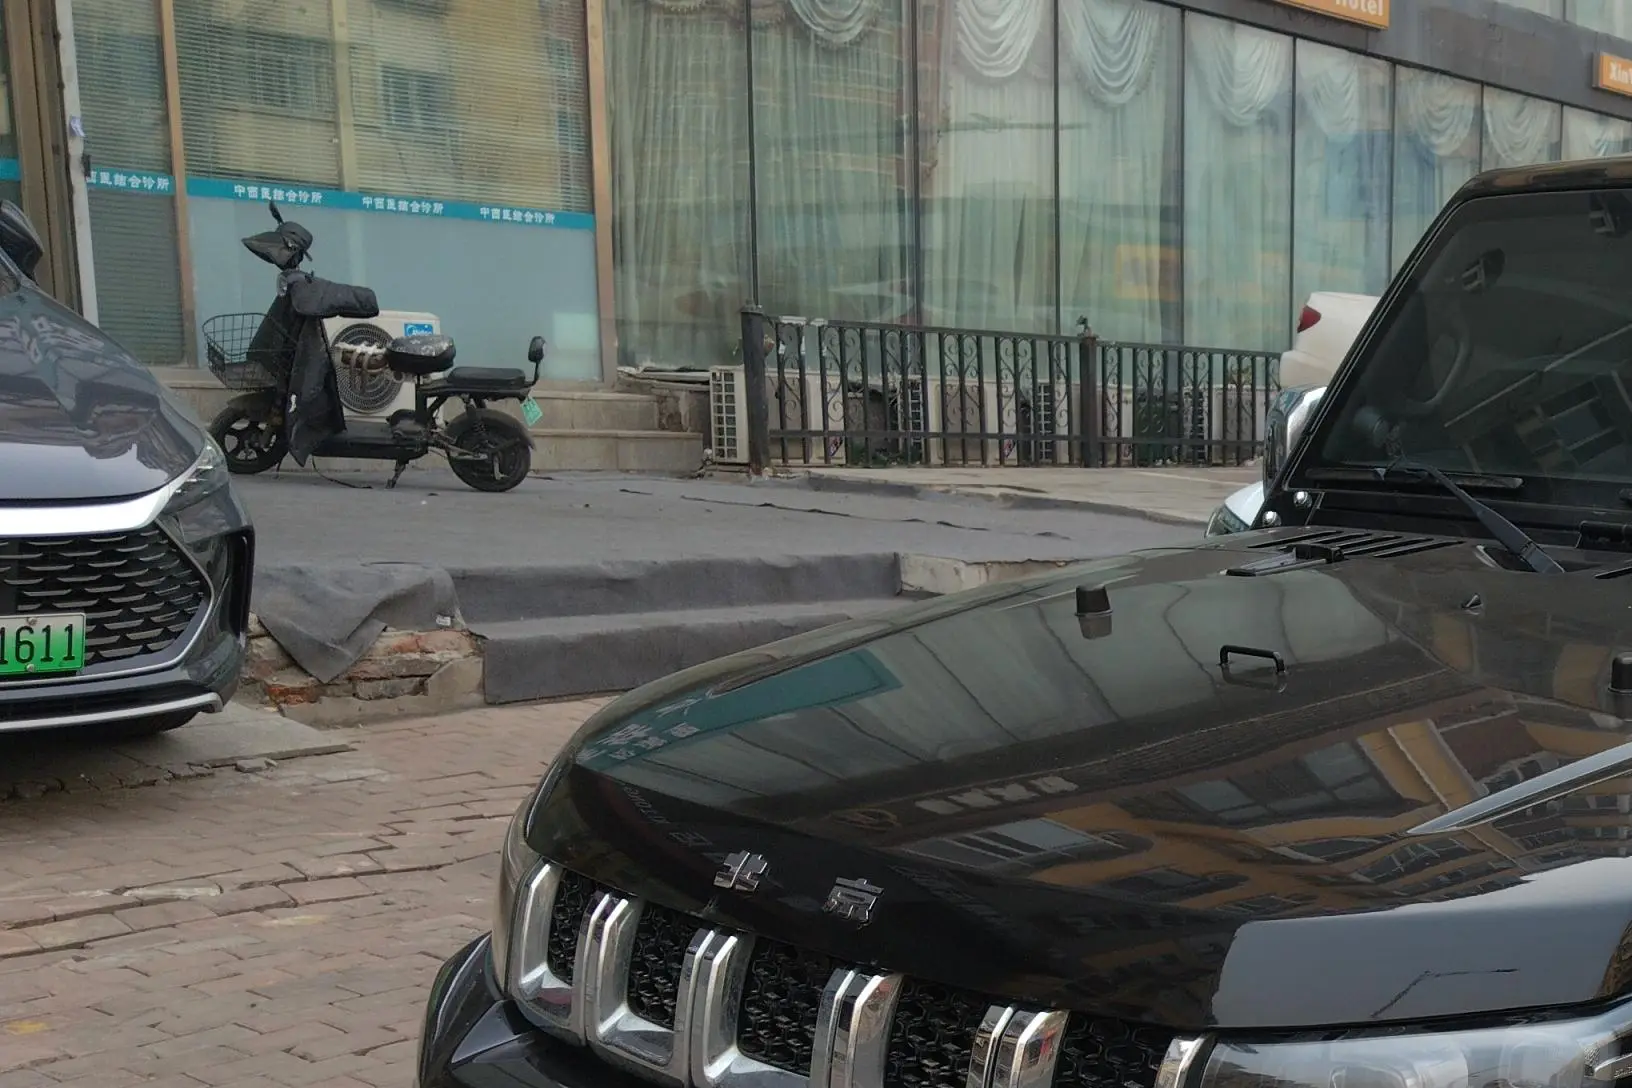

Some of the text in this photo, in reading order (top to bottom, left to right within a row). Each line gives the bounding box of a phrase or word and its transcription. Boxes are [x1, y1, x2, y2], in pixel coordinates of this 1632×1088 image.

[234, 184, 322, 204] 中西医结合诊所
[362, 195, 444, 215] 中西医结合诊所
[480, 206, 555, 225] 中西医结合诊所
[0, 624, 75, 665] 1611
